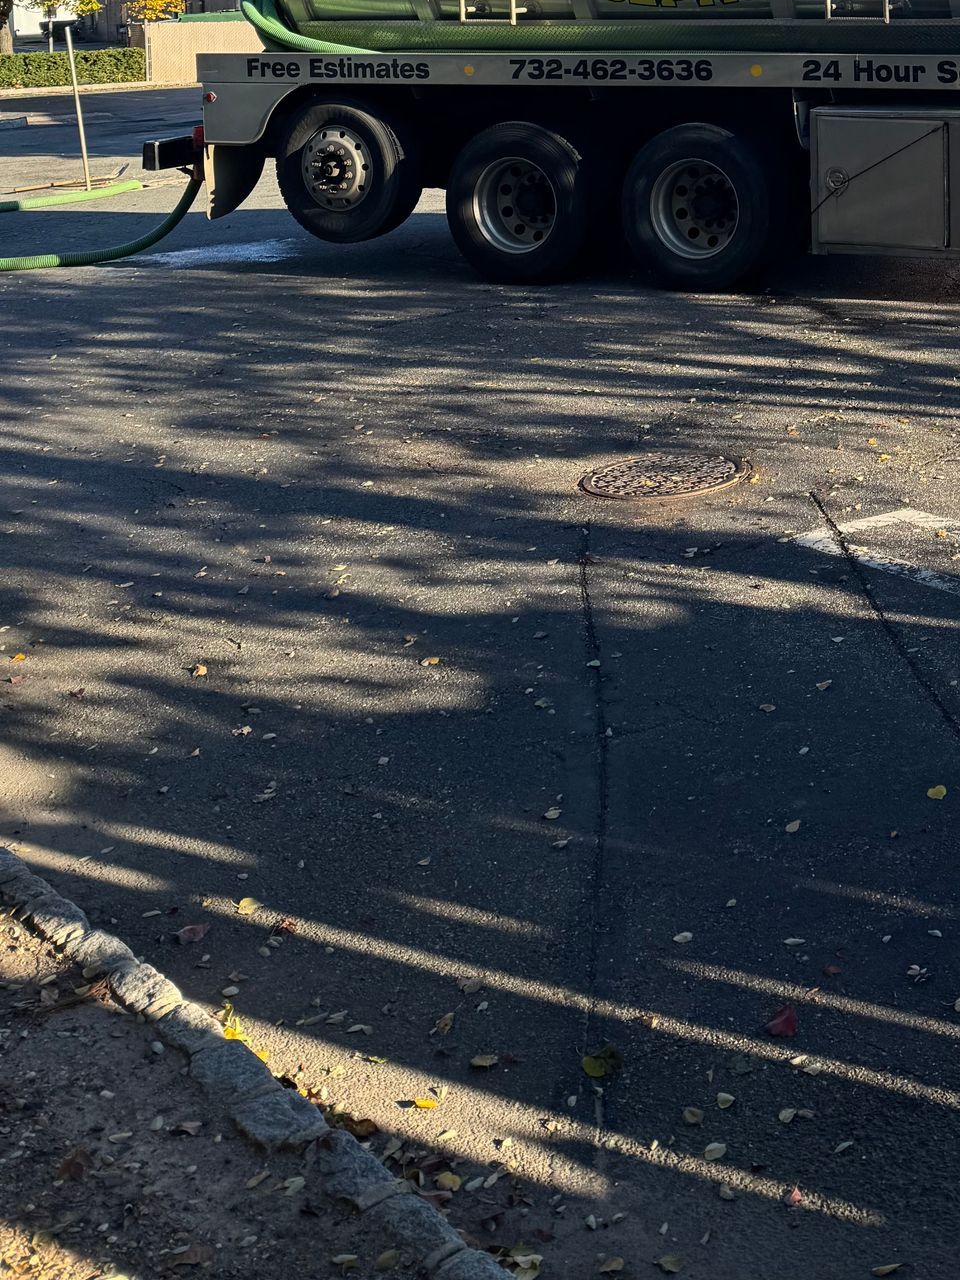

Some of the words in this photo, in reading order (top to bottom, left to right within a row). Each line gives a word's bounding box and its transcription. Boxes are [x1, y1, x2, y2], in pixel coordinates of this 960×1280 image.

[246, 58, 300, 78] Free
[308, 58, 430, 79] Estimates
[509, 59, 713, 81] 732-462-3636
[802, 60, 842, 81] 24
[853, 60, 926, 83] Hour
